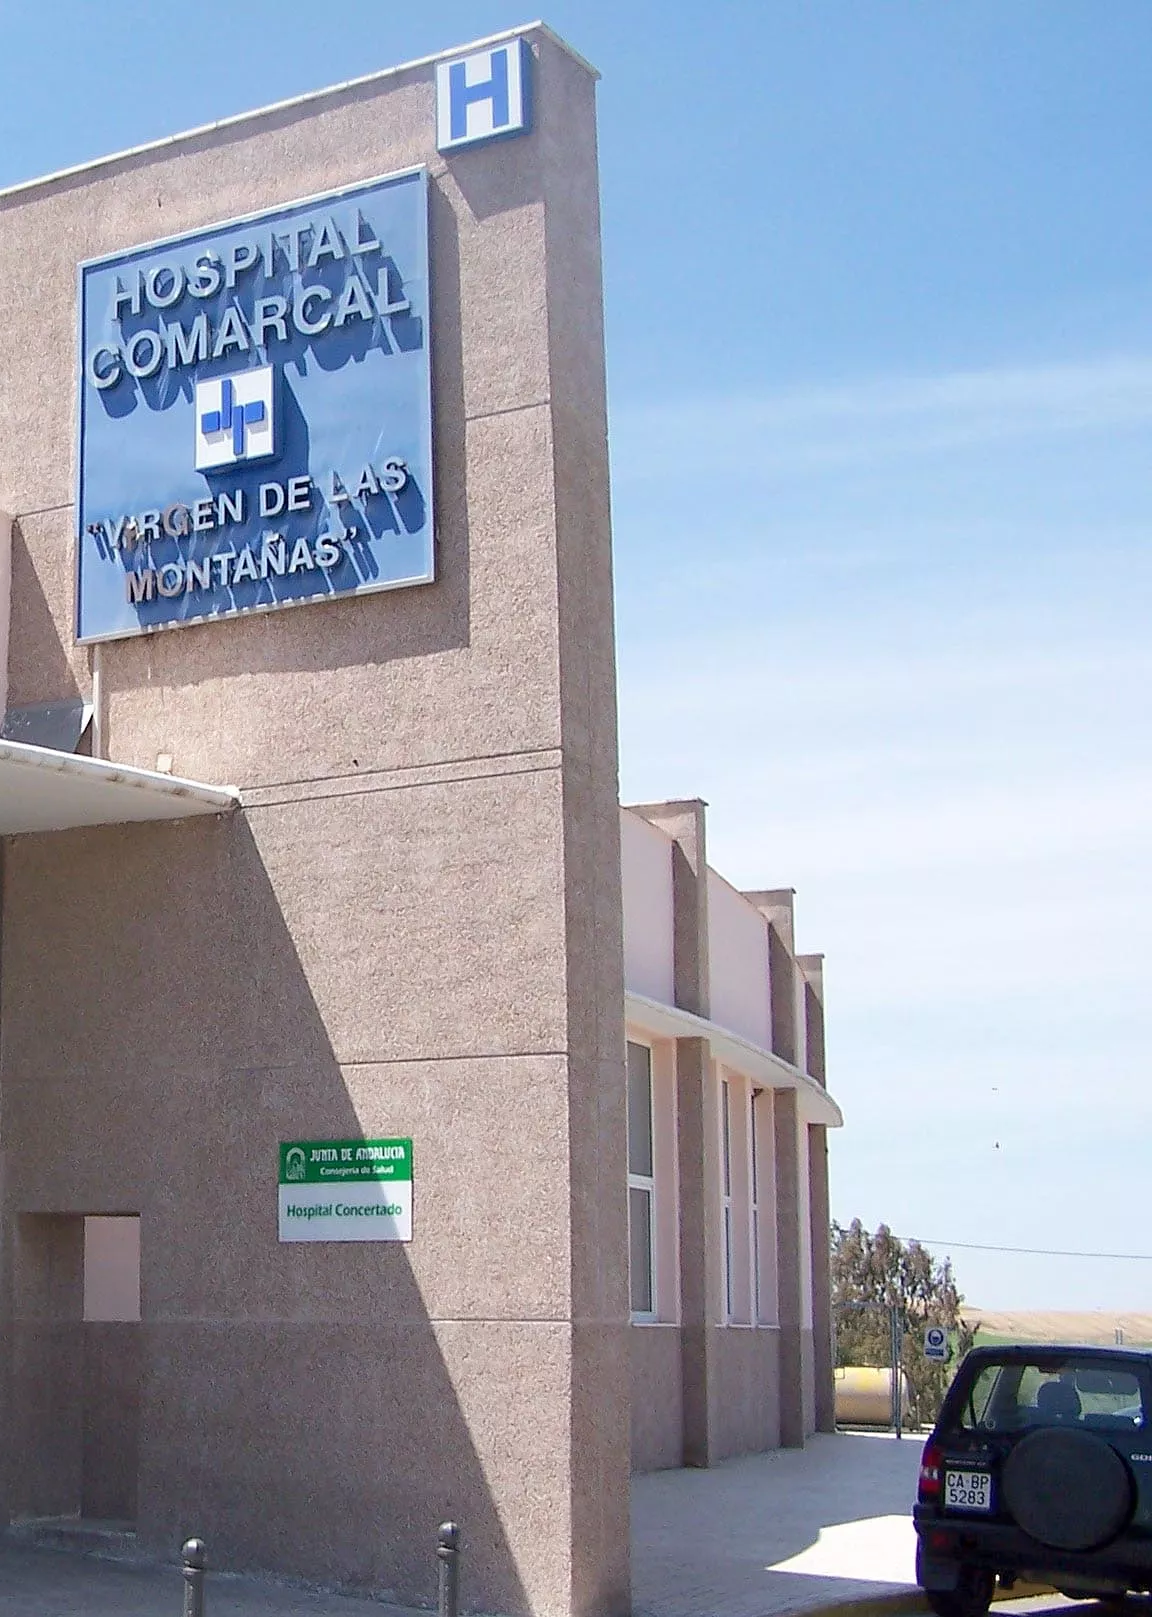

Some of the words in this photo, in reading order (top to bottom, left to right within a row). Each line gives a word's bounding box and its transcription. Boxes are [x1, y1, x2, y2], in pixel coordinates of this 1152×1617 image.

[449, 48, 509, 140] H
[111, 208, 381, 320] HOSPITAL
[89, 267, 410, 389] COMARCAL
[259, 475, 313, 518] DE
[329, 456, 408, 502] LAS
[310, 1148, 338, 1162] JUNTA
[341, 1148, 353, 1160] DE
[286, 1203, 333, 1221] Hospital
[335, 1203, 402, 1218] Concertado
[950, 1489, 985, 1505] 5283
